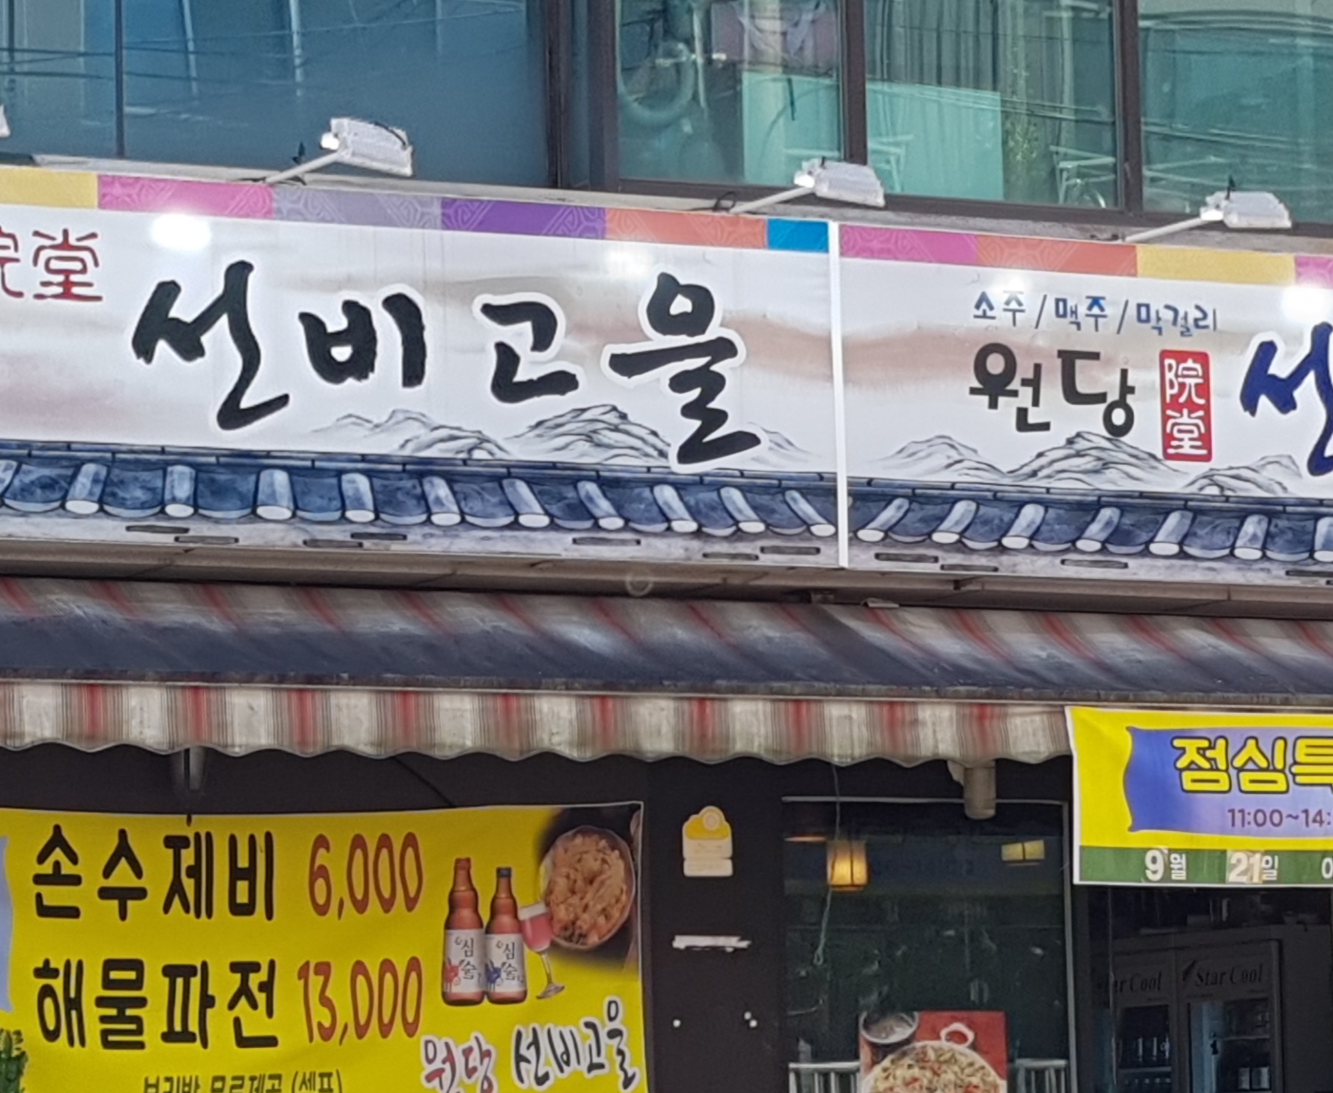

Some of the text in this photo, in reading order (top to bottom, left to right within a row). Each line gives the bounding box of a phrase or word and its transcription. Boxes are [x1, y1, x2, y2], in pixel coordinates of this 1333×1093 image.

[131, 261, 762, 464] 선비고을
[969, 342, 1136, 437] 원당
[1163, 358, 1208, 455] 院堂
[32, 823, 424, 922] 손수제비 6,000
[32, 955, 423, 1051] 해물파전 13,000
[513, 999, 637, 1091] 선비고을
